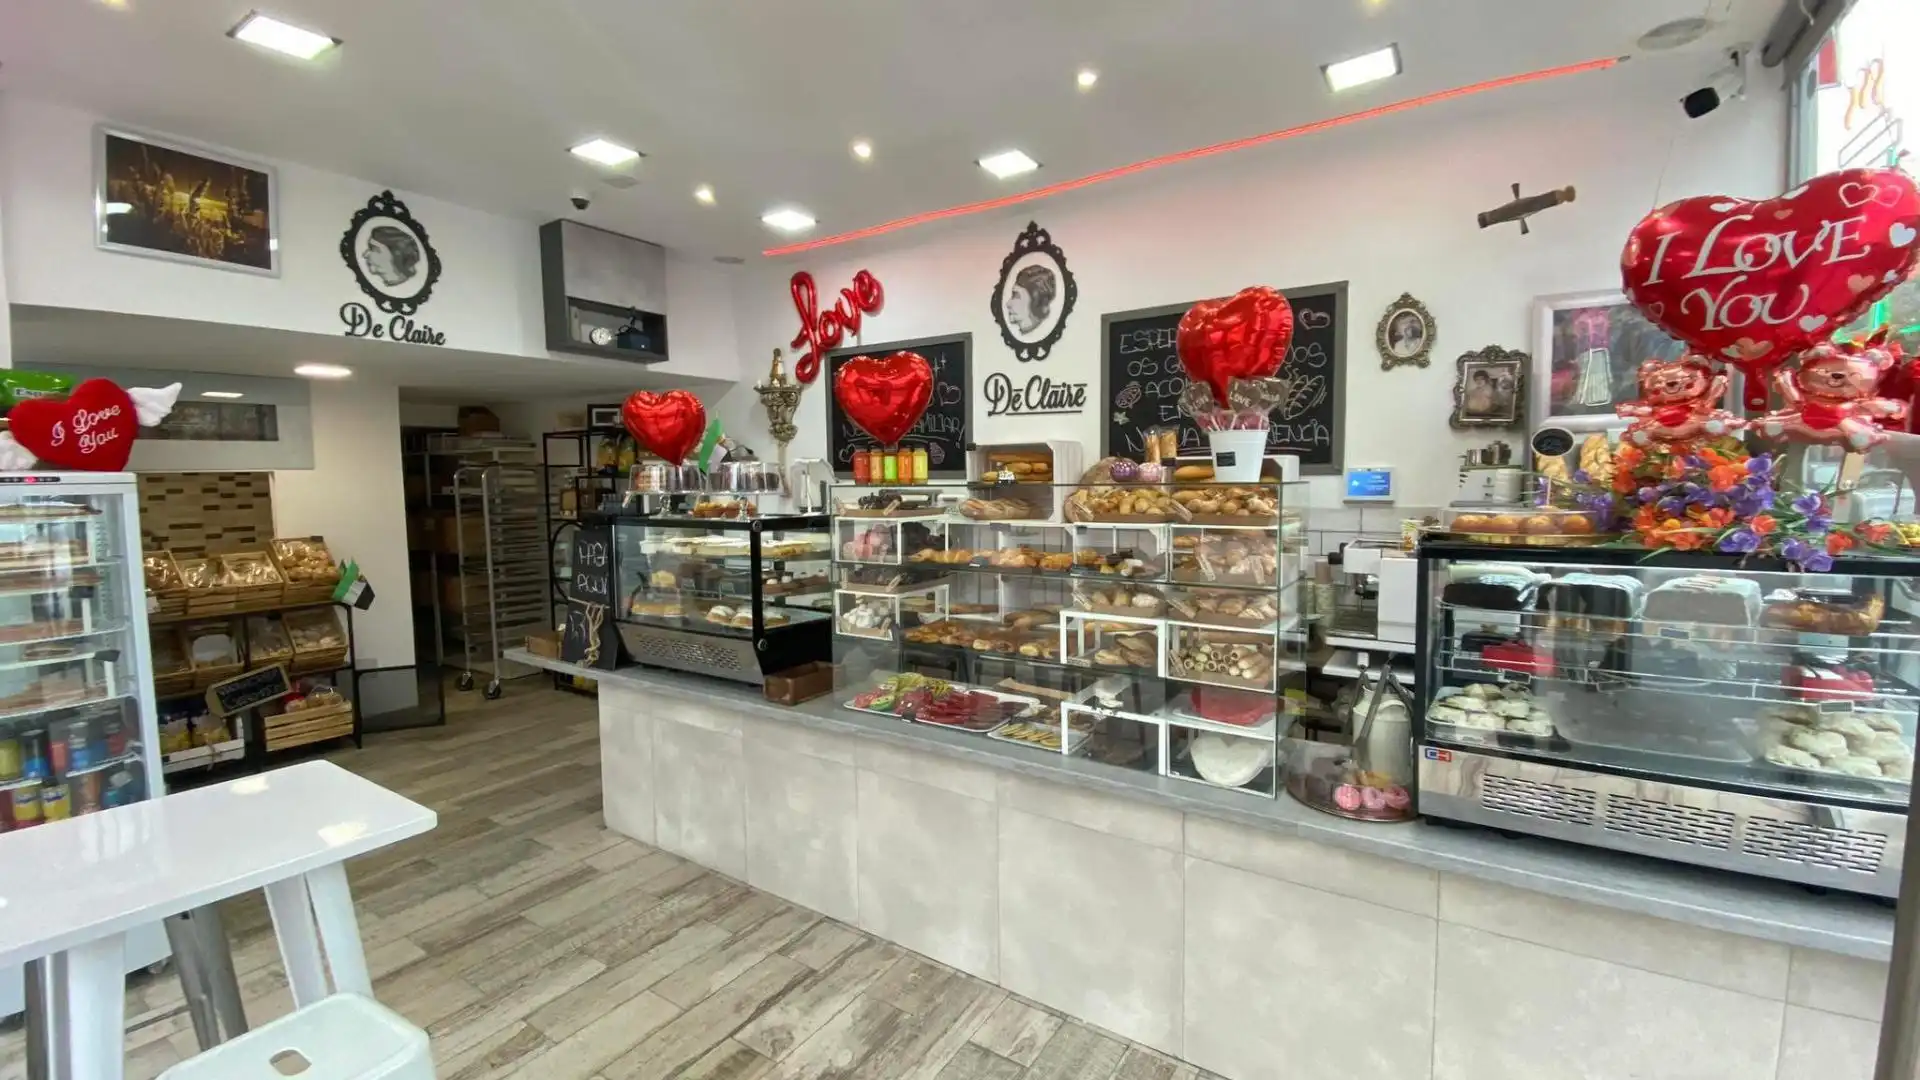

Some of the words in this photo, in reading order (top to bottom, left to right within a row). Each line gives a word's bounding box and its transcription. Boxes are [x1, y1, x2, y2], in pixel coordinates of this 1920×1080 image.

[1642, 231, 1683, 286] I
[1680, 214, 1871, 280] LOVE
[339, 302, 384, 338] De
[389, 315, 446, 346] Claire
[1680, 275, 1809, 331] YOU
[983, 372, 1023, 417] De
[1025, 375, 1088, 410] Claire
